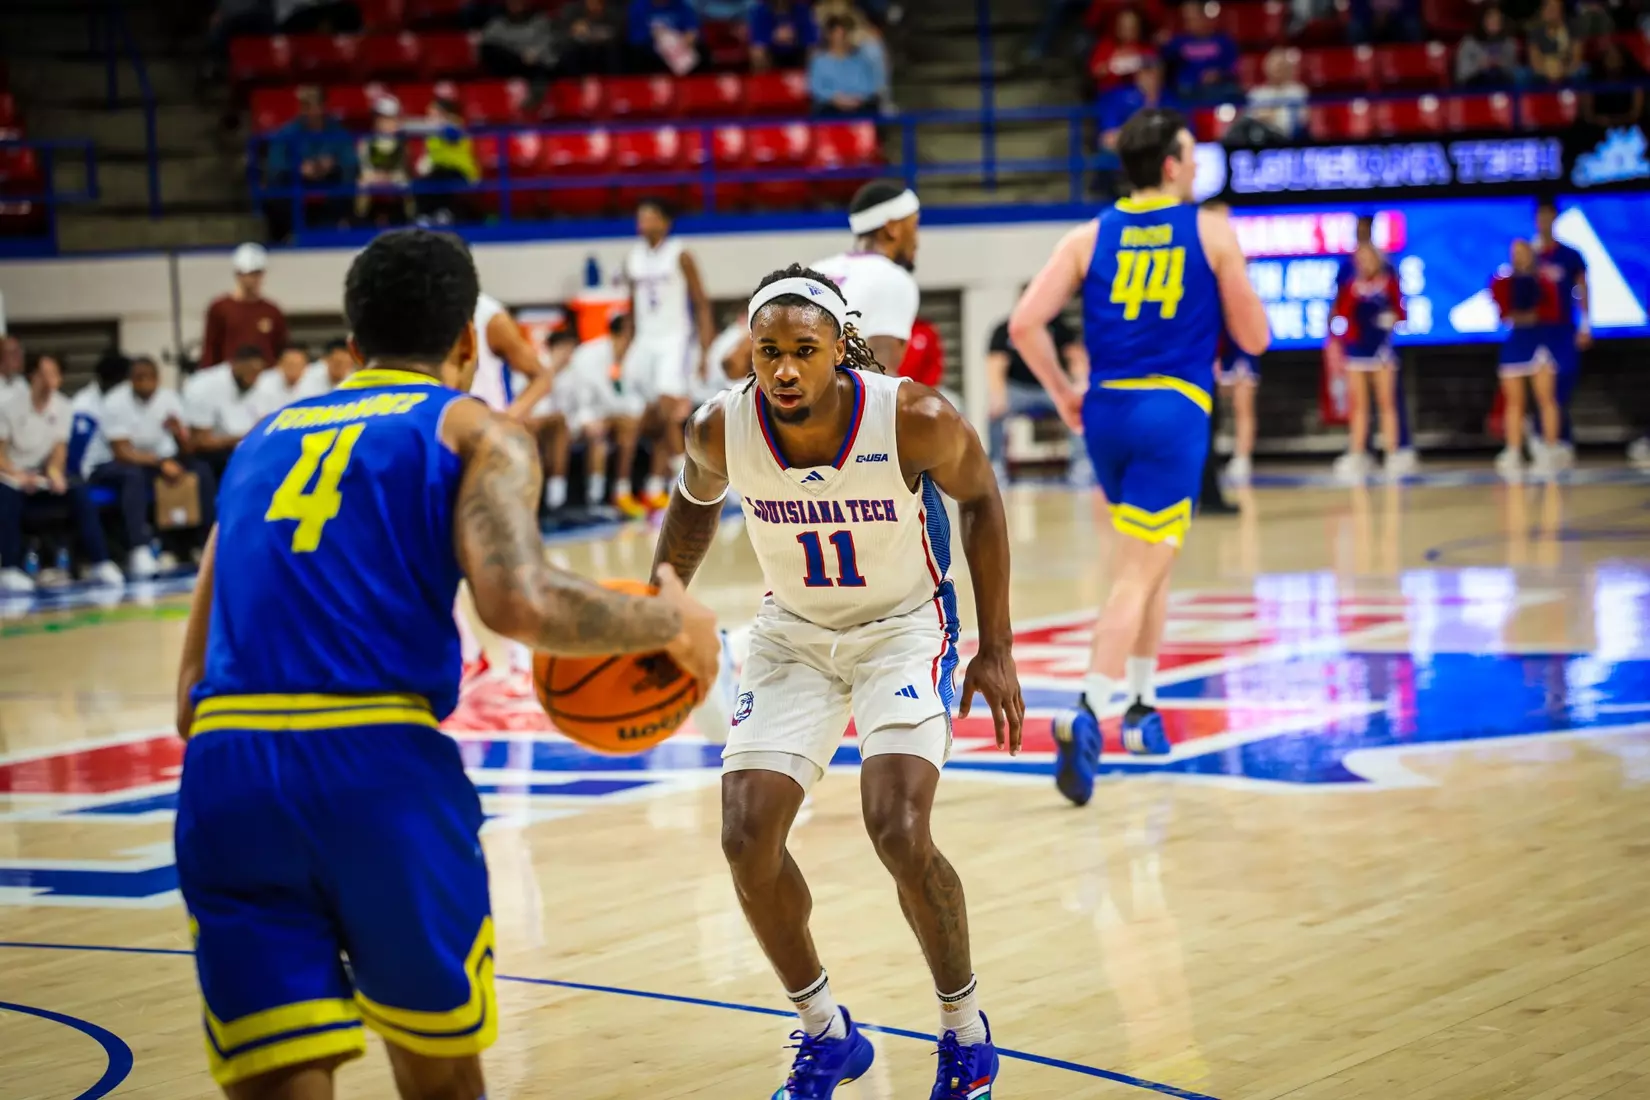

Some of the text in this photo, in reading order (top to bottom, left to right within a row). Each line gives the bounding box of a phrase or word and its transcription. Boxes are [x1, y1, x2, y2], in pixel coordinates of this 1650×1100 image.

[1450, 138, 1562, 184] TECH
[1109, 246, 1185, 320] 44
[264, 421, 367, 553] 4
[744, 496, 898, 524] LOUISIANA TECH
[796, 530, 867, 587] 11
